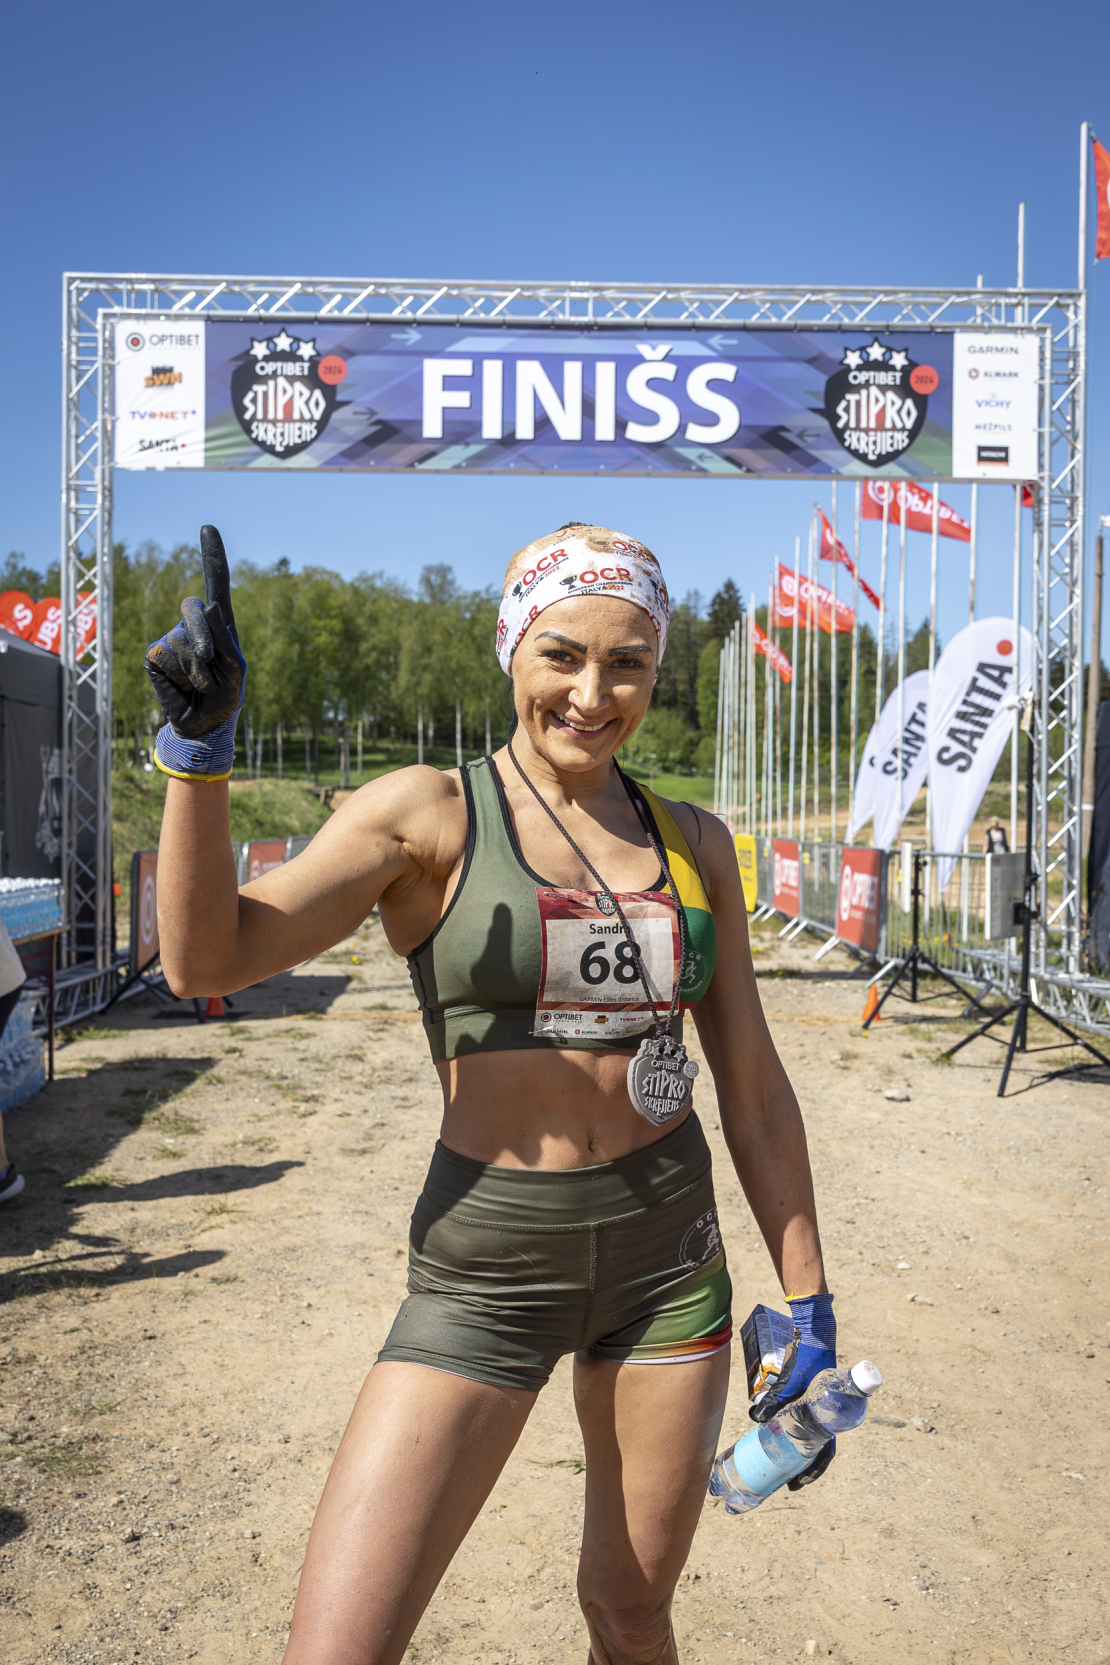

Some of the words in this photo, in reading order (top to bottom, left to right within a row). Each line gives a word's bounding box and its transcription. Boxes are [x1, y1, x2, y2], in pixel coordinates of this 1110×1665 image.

[149, 333, 200, 346] OPTIBET
[967, 345, 1020, 356] GARMIN
[255, 361, 310, 376] OPTIBET
[323, 365, 343, 375] 2024
[144, 372, 182, 388] SWH
[848, 370, 903, 385] OPTIBET
[242, 376, 326, 420] STIPRO
[422, 344, 741, 444] FINIŠS
[835, 385, 918, 430] STIPRO
[975, 399, 1012, 410] VICHY
[522, 548, 568, 586] OCR
[579, 567, 634, 584] OCR
[936, 662, 1014, 773] SANTA
[579, 941, 641, 985] 68
[553, 1013, 583, 1021] OPTIBET
[651, 1060, 680, 1071] OPTIBET
[642, 1069, 686, 1099] STIPRO
